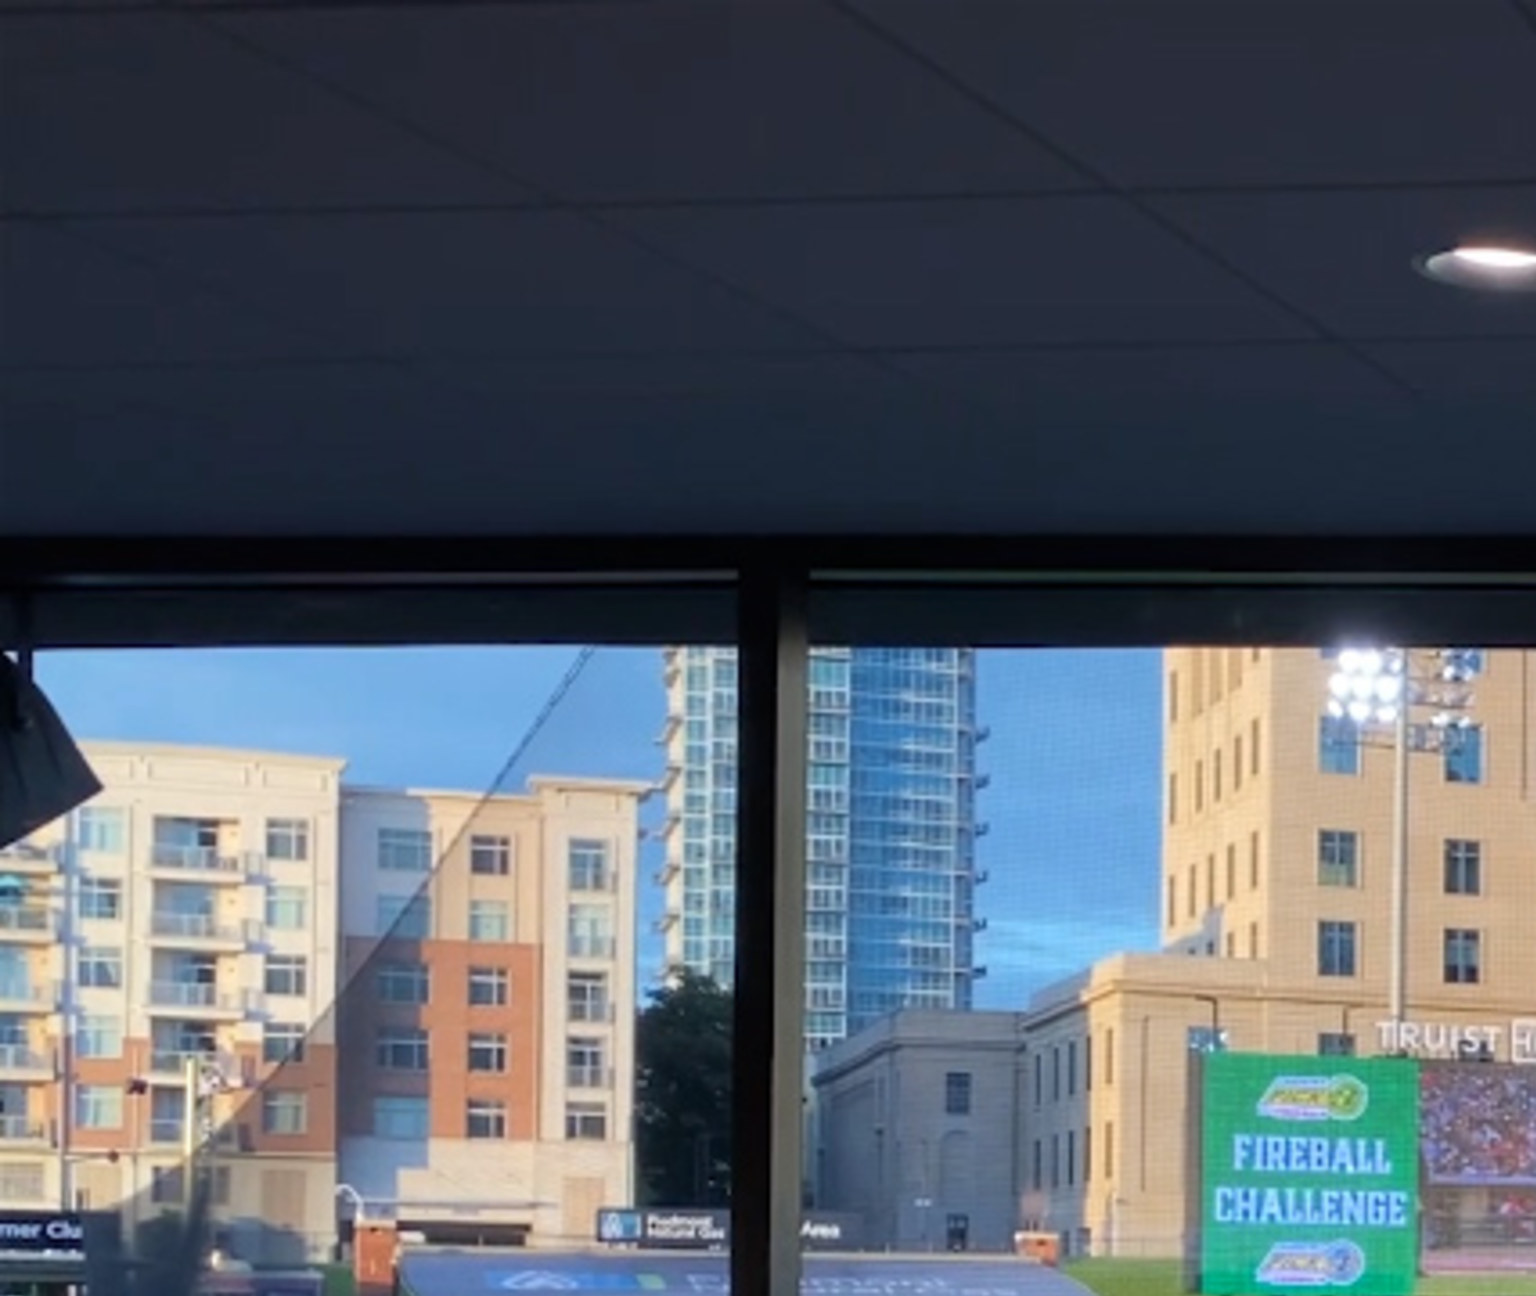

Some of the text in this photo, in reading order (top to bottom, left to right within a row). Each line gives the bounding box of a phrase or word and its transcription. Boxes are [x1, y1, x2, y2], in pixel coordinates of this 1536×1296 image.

[1375, 1020, 1502, 1051] TRUIST
[1233, 1134, 1393, 1175] FIREBALL
[1214, 1185, 1408, 1226] CHALLENGE
[800, 1220, 841, 1238] Area
